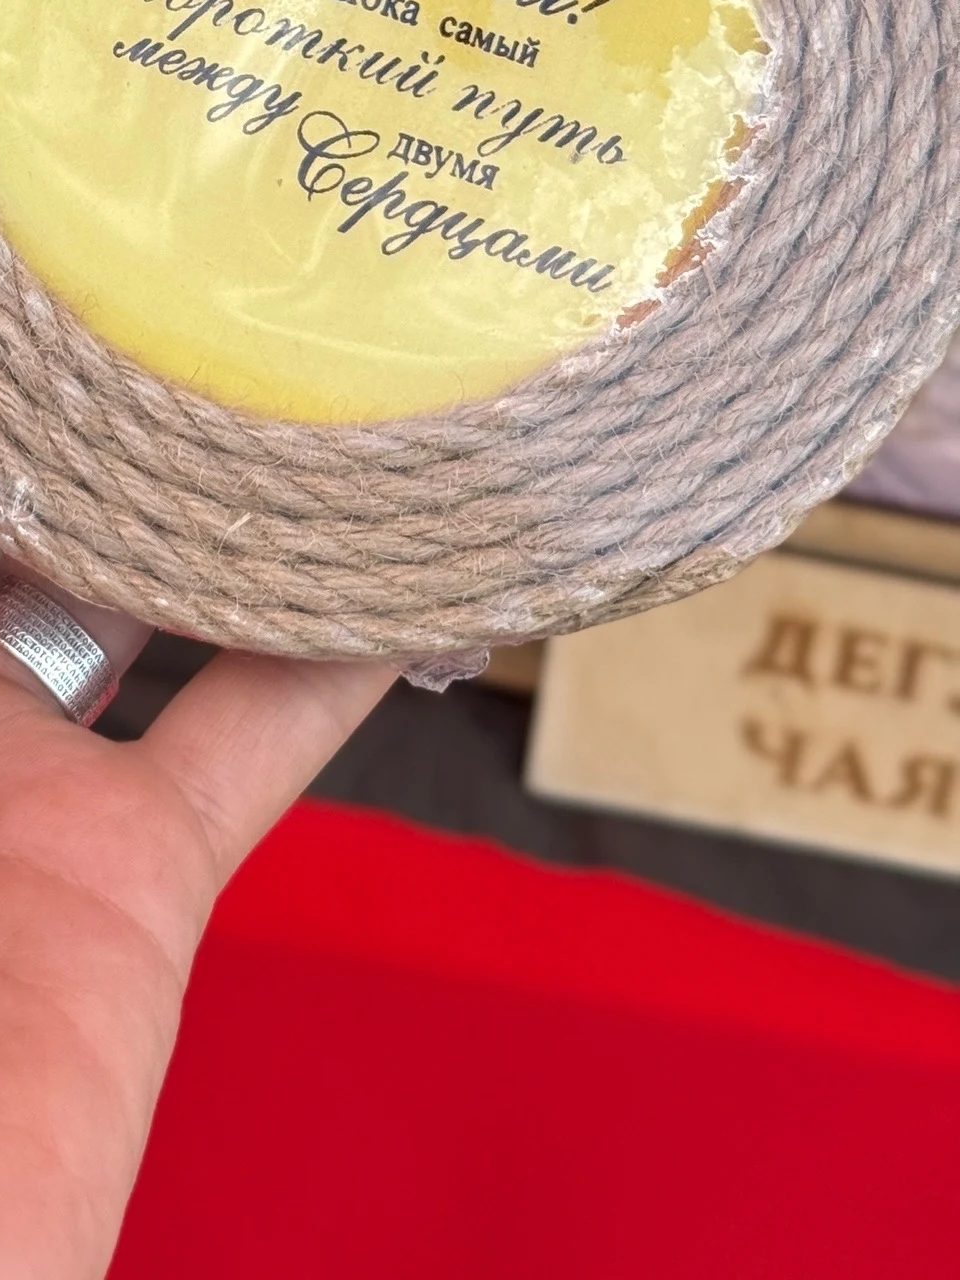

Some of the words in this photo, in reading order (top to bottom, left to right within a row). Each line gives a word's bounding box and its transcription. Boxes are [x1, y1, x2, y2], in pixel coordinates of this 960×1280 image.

[439, 13, 541, 68] самый
[113, 34, 304, 136] между
[387, 131, 500, 191] двумя
[451, 81, 628, 165] путь
[297, 110, 620, 293] Сердцами
[742, 612, 960, 718] ДЕГ
